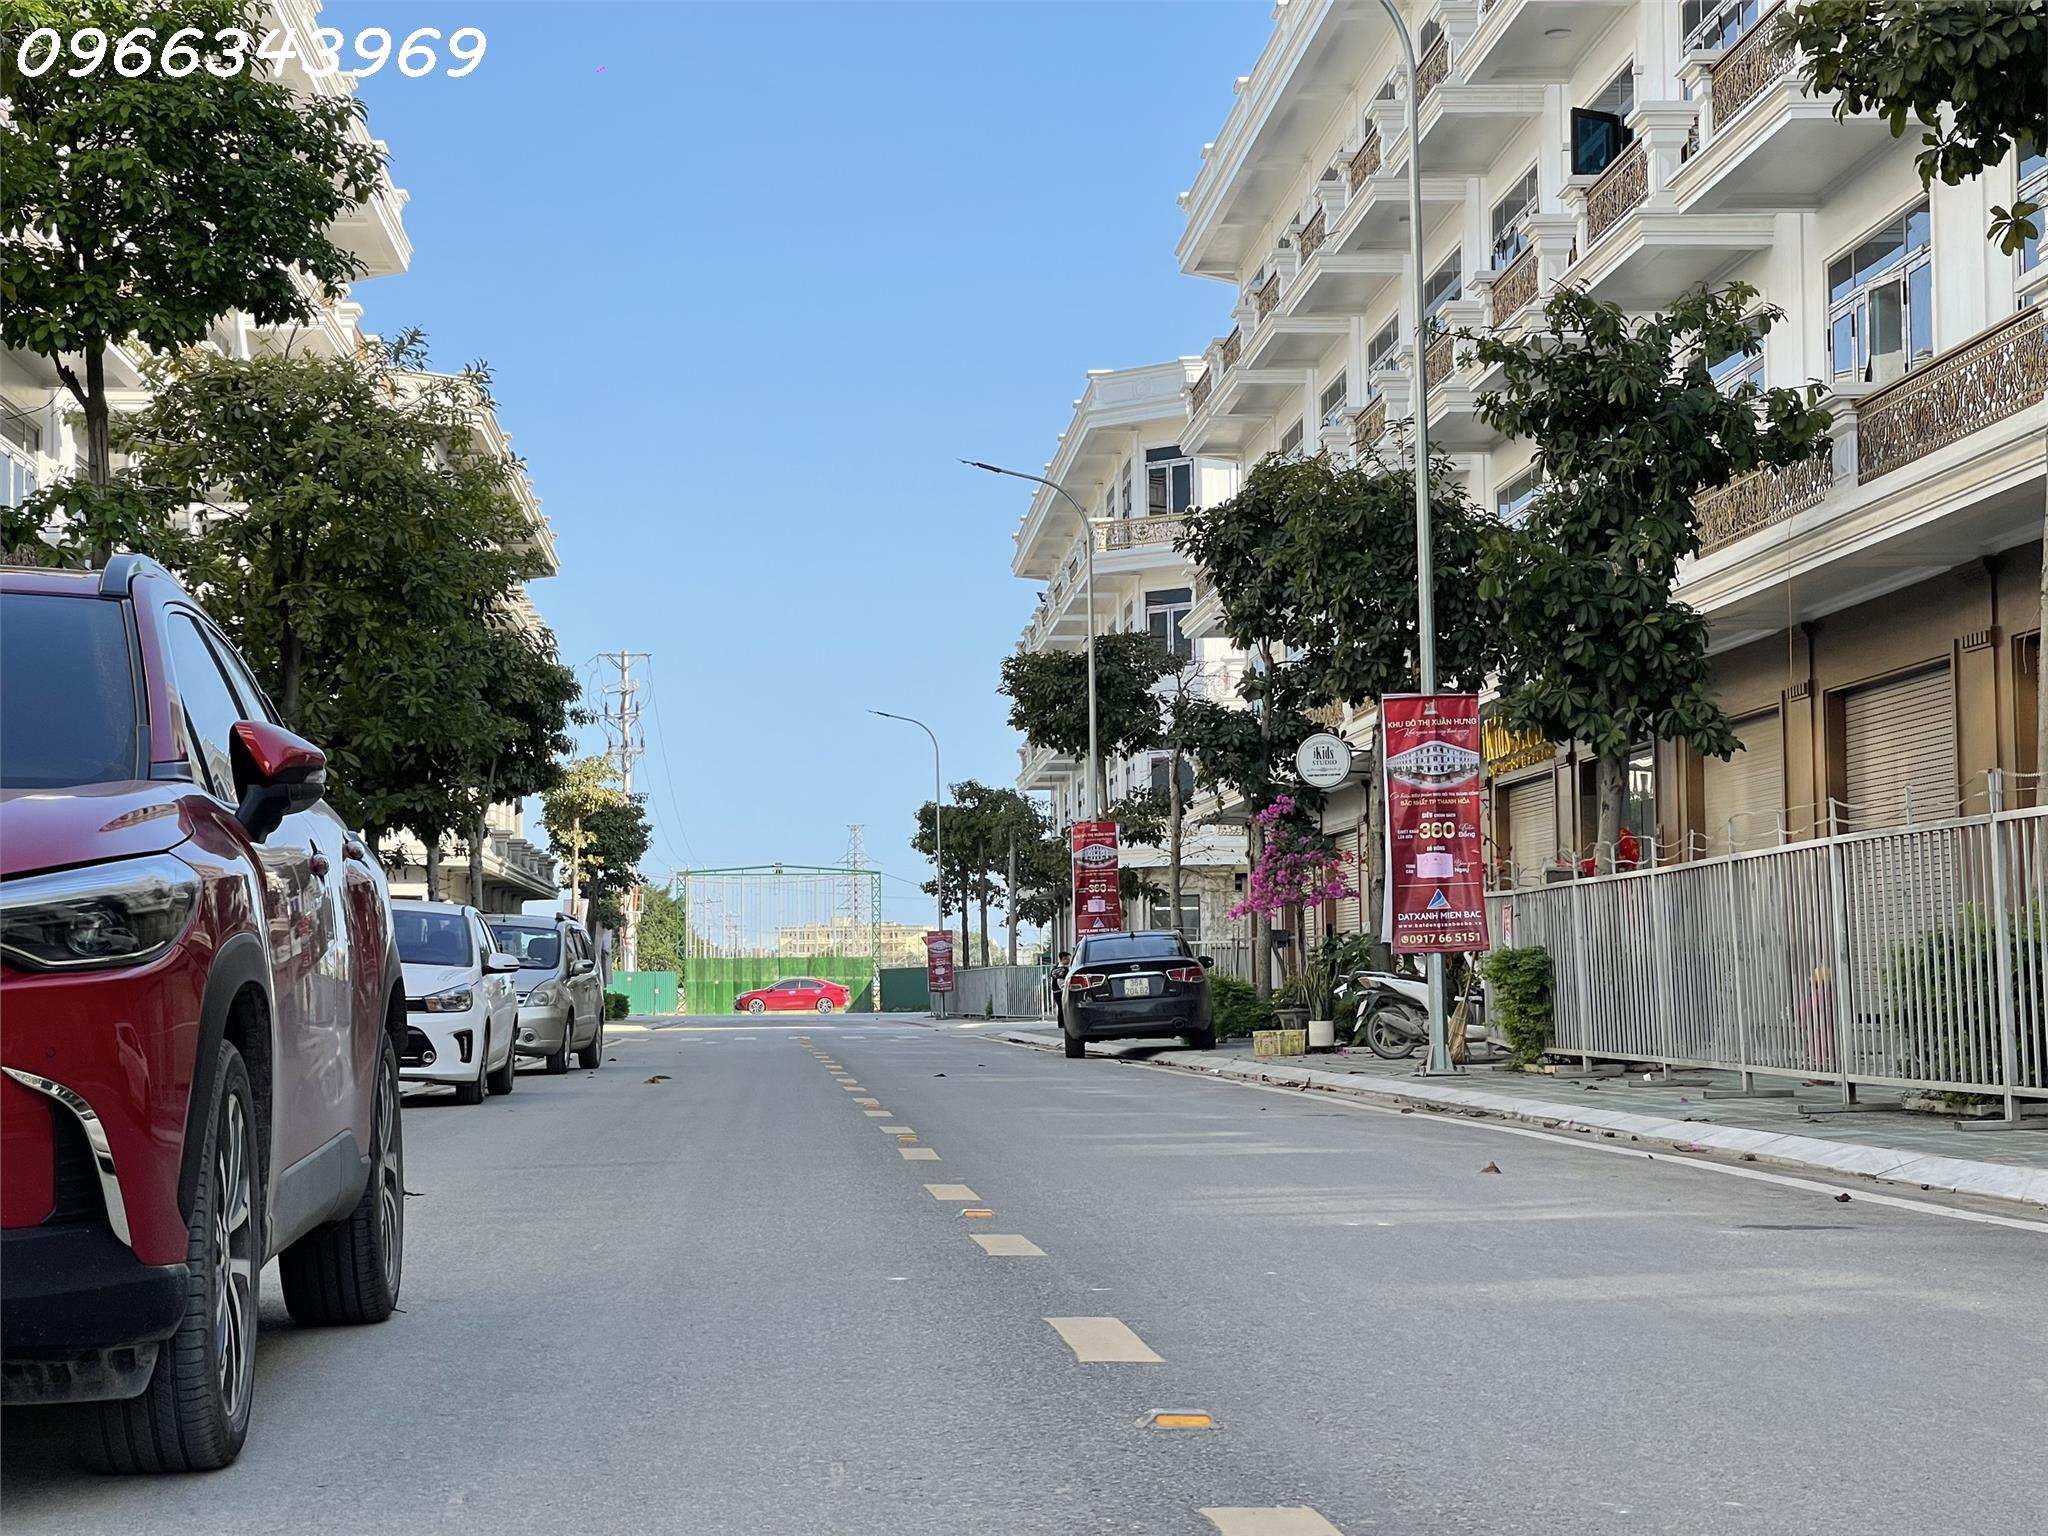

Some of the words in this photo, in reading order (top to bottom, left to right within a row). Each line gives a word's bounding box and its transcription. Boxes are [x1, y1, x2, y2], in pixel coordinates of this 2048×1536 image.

[1387, 721, 1404, 729] KHU
[1431, 717, 1452, 726] XUÂN
[1453, 717, 1477, 725] HƯNG
[1420, 821, 1456, 839] 360
[1398, 912, 1438, 921] DATXANH
[1440, 911, 1462, 919] MIEN
[1463, 910, 1482, 918] BAC
[1409, 933, 1436, 944] 0917
[1438, 933, 1453, 943] 66
[1455, 932, 1481, 942] 5151
